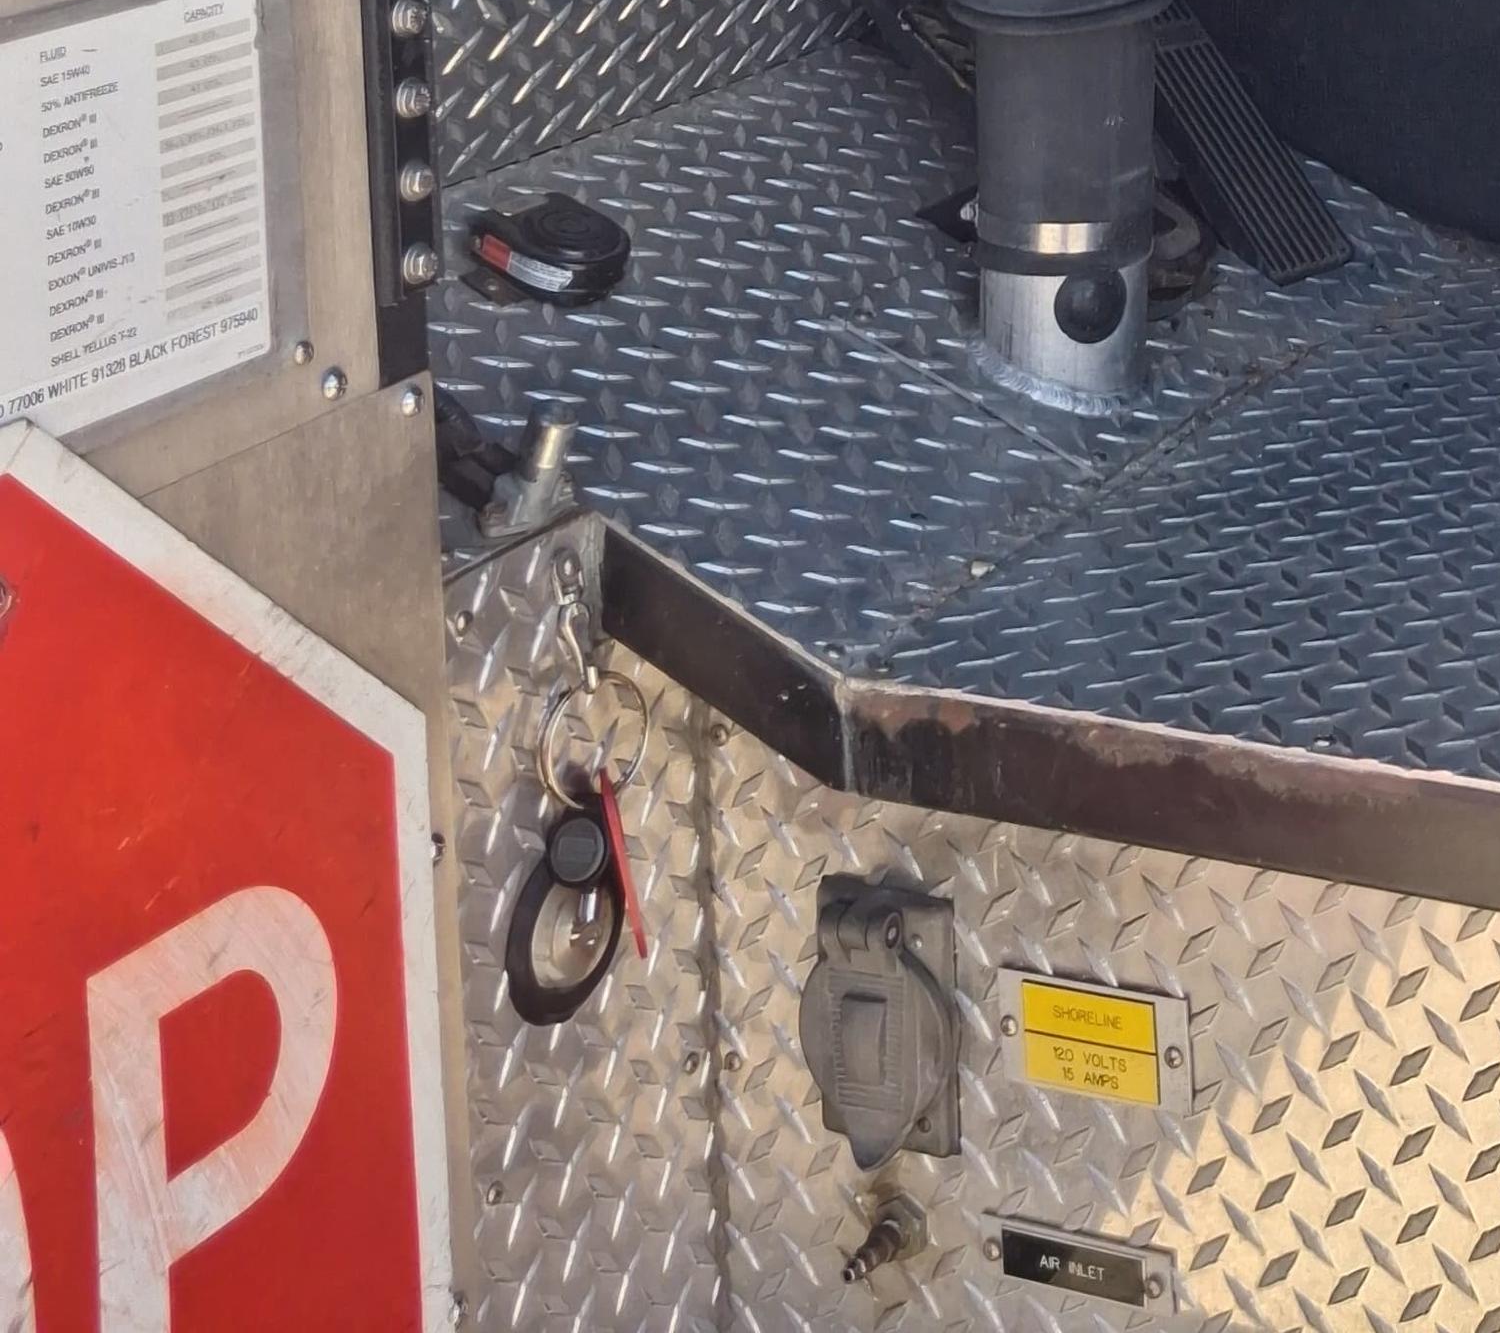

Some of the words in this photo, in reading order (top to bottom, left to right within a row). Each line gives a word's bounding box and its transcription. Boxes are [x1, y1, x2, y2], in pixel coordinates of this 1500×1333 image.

[184, 2, 225, 23] CAPACITY
[40, 46, 67, 63] FLUID
[40, 73, 60, 87] SAE
[61, 64, 91, 81] 15W40
[64, 81, 119, 106] ANTIFREEZE
[44, 174, 63, 189] SAE
[46, 225, 65, 240] SAE
[8, 388, 44, 415] 77006
[48, 372, 89, 399] WHITE
[91, 358, 126, 383] 91328
[129, 342, 168, 369] BLACK
[172, 322, 218, 354] FOREST
[220, 307, 258, 334] 975940
[51, 348, 81, 367] SHELL
[83, 332, 117, 354] TELLUS
[1052, 1005, 1123, 1030] SHORELINE
[1053, 1046, 1074, 1062] 120
[1083, 1051, 1127, 1073] VOLTS
[1062, 1066, 1074, 1081] 15
[1084, 1072, 1119, 1090] AMPS
[1040, 1255, 1062, 1271] AIR
[1069, 1262, 1105, 1282] INLET
